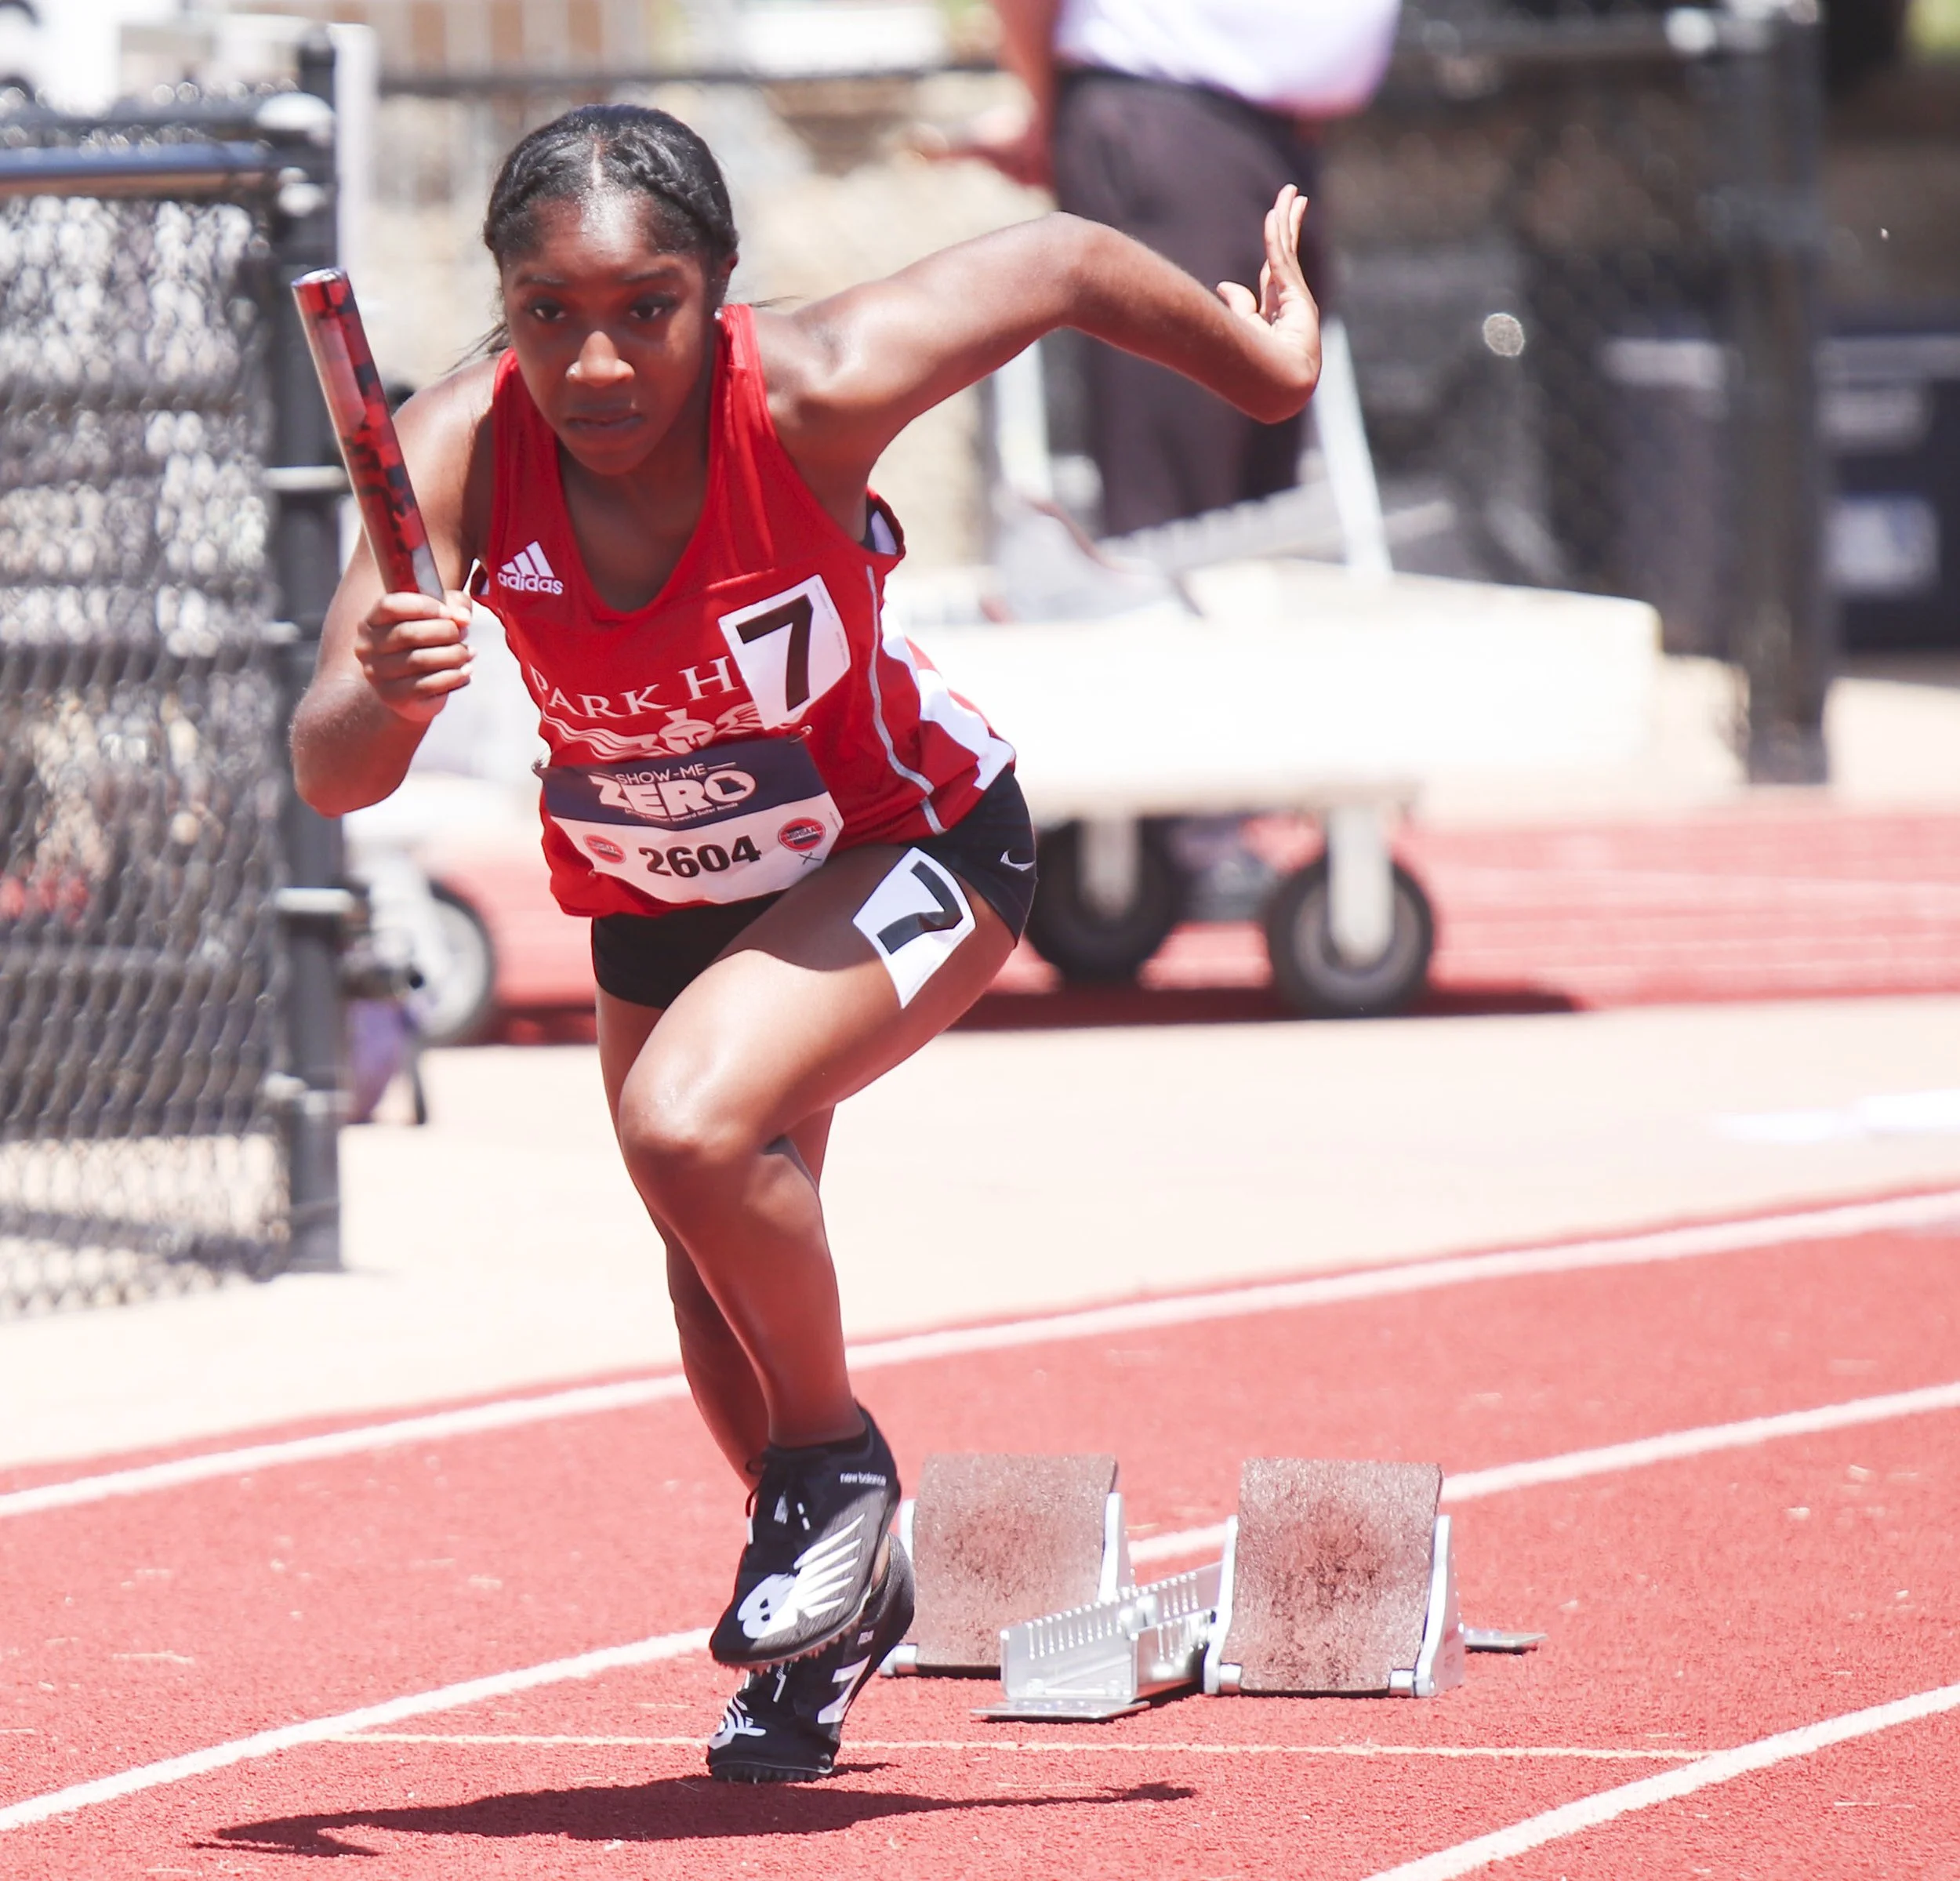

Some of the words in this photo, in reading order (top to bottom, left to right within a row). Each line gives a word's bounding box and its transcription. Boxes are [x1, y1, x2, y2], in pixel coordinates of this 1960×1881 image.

[497, 572, 564, 595] adidas
[735, 594, 814, 712] 7
[528, 663, 672, 719] PARK
[588, 769, 756, 817] ZERO
[615, 763, 706, 784] SHOW-ME
[638, 835, 762, 877] 2604
[876, 860, 964, 955] 7
